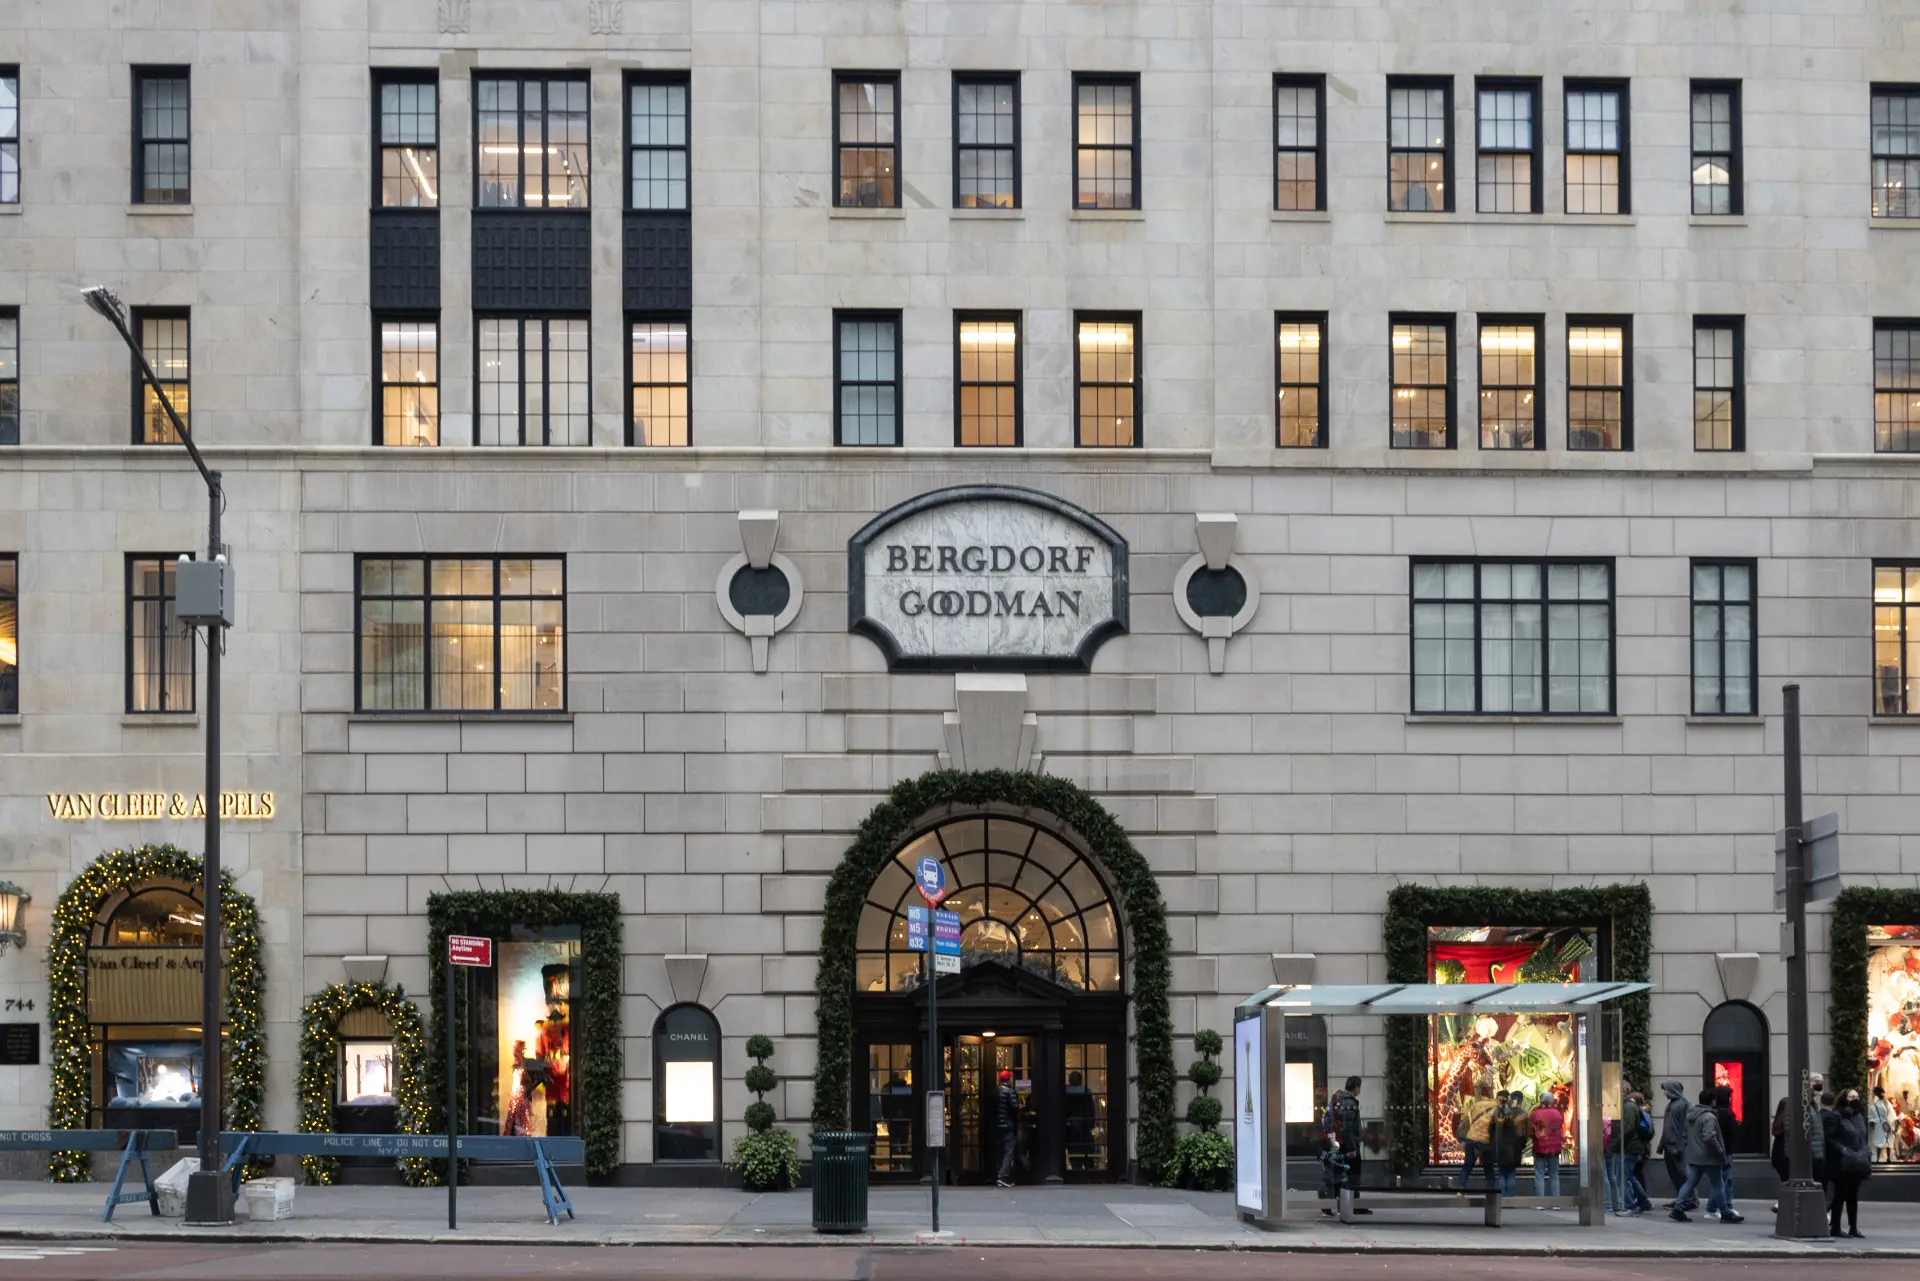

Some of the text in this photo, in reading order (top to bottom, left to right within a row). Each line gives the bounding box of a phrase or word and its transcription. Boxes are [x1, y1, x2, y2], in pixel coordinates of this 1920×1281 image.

[886, 545, 1095, 573] BERGDORF
[899, 590, 1082, 617] GOODMAN
[47, 793, 272, 817] VAN CLEEF & APELS
[909, 909, 921, 920] M5
[909, 923, 921, 934] M5
[452, 945, 473, 953] Anytime
[460, 939, 485, 948] STANDING
[90, 956, 118, 969] Van
[121, 956, 164, 969] Cleef
[5, 999, 35, 1011] 744
[670, 1033, 709, 1041] CHANEL
[1285, 1032, 1309, 1040] ANEL
[0, 1132, 52, 1142] NOT CROSS
[324, 1137, 354, 1147] POLICE
[363, 1138, 382, 1147] LINE
[412, 1139, 429, 1148] NOT
[433, 1139, 463, 1149] CRS
